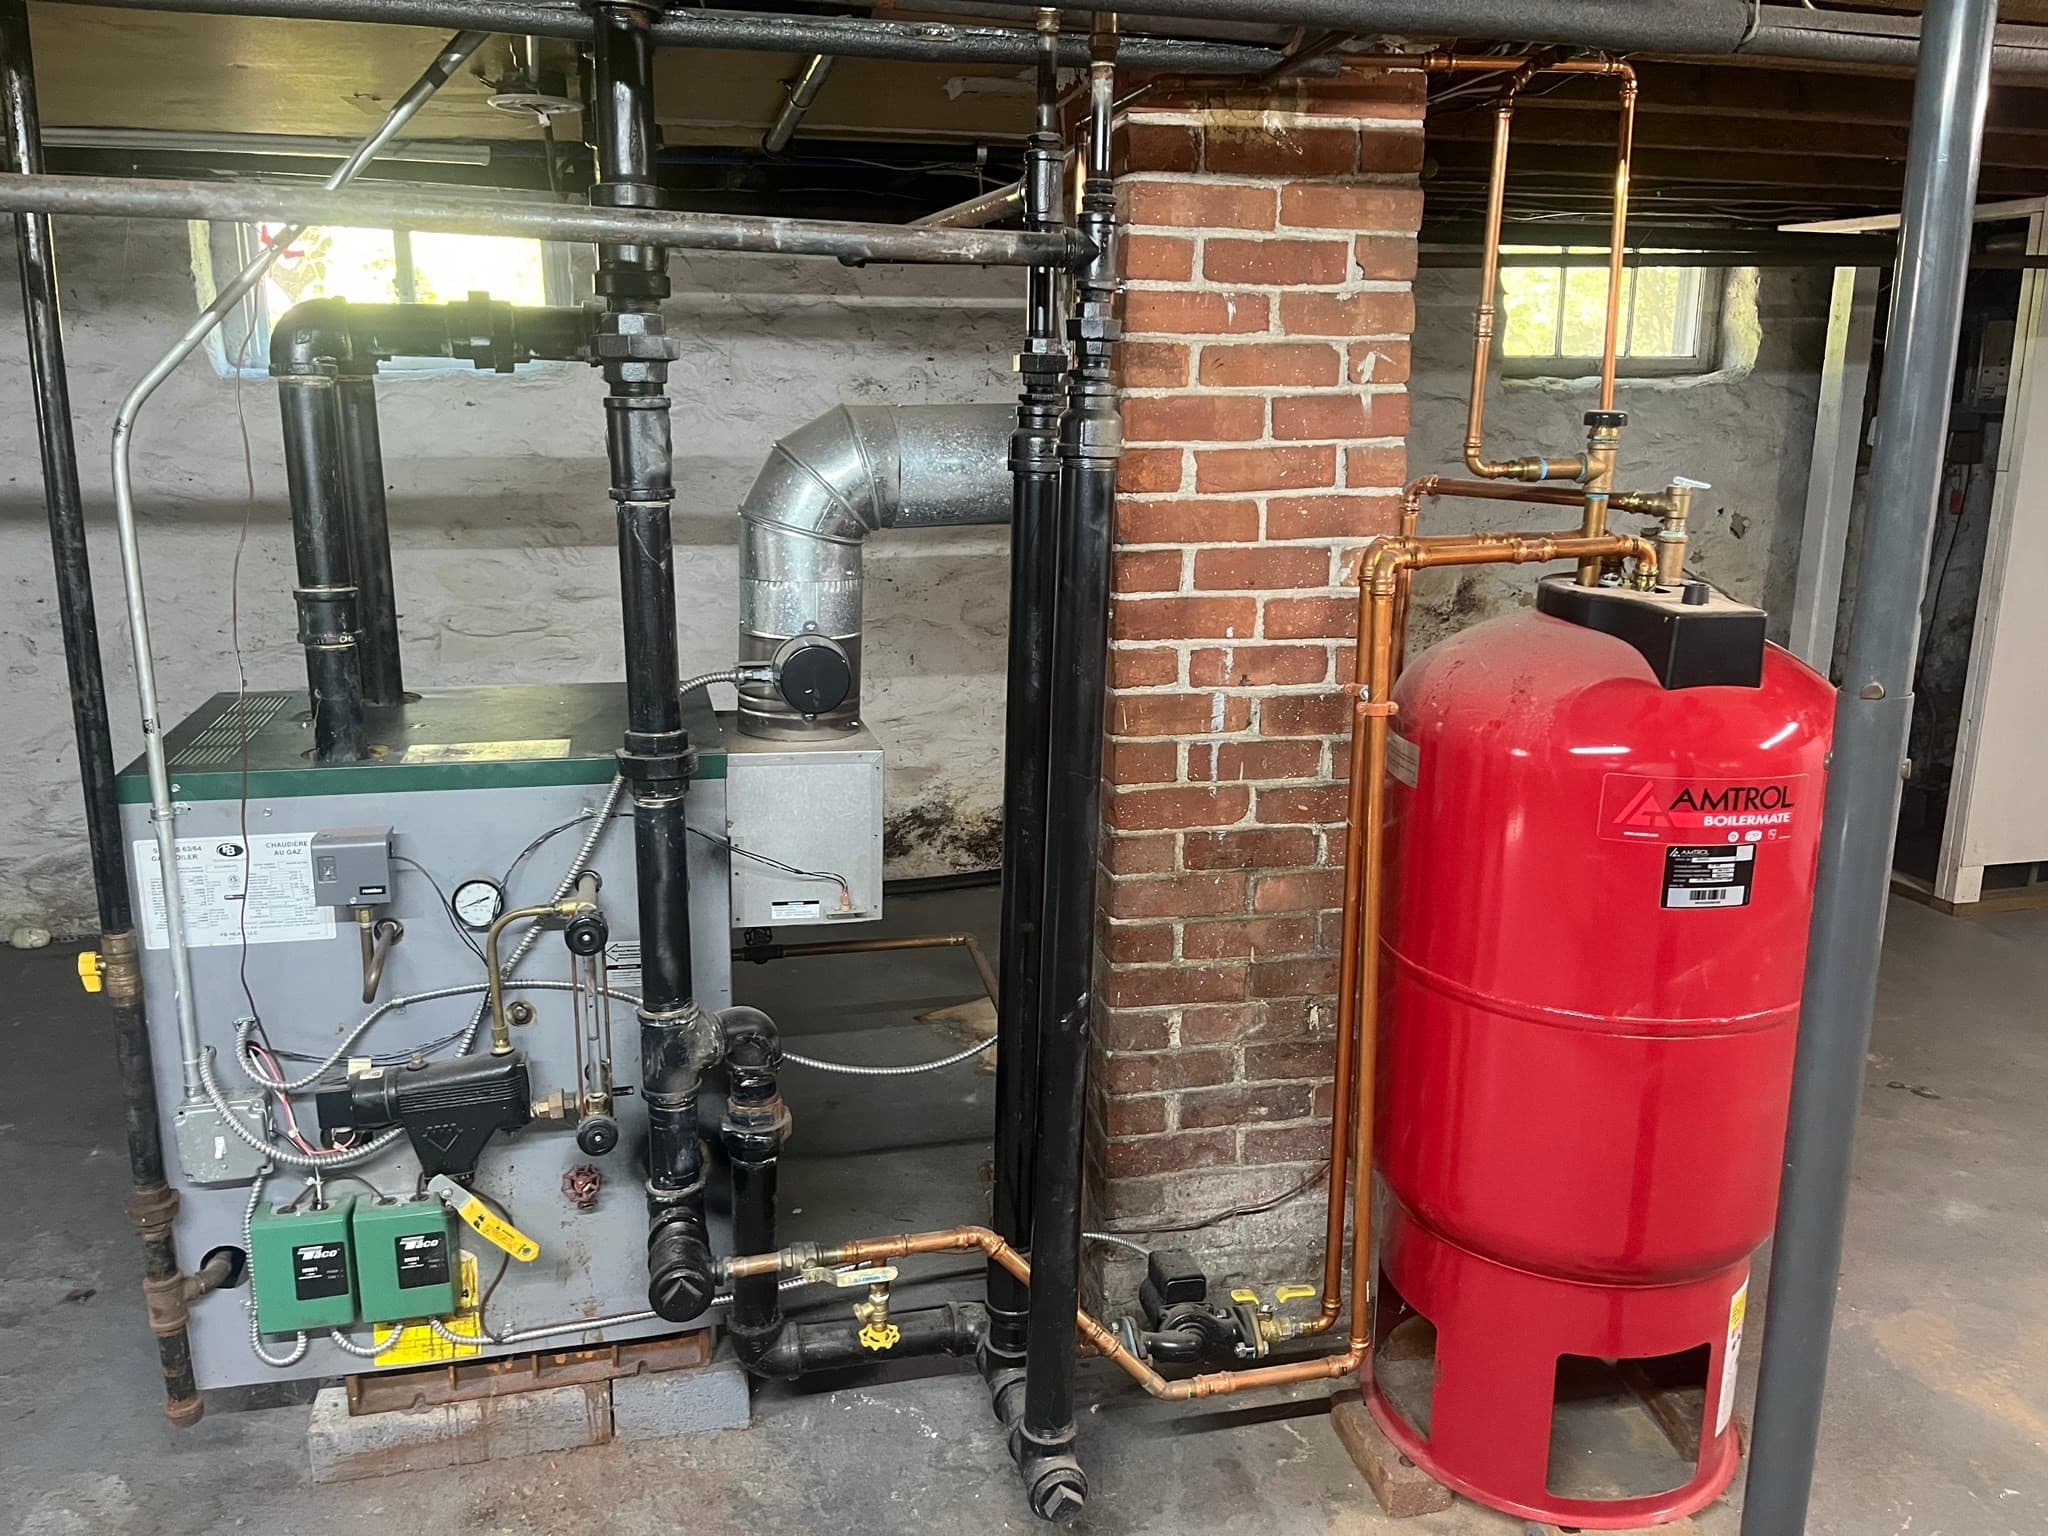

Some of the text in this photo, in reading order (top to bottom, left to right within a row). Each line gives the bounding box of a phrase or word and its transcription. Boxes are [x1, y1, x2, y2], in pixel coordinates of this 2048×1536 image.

[1669, 785, 1794, 811] AMTROL
[1703, 812, 1791, 827] BOILERMATE
[297, 1245, 338, 1261] Taco
